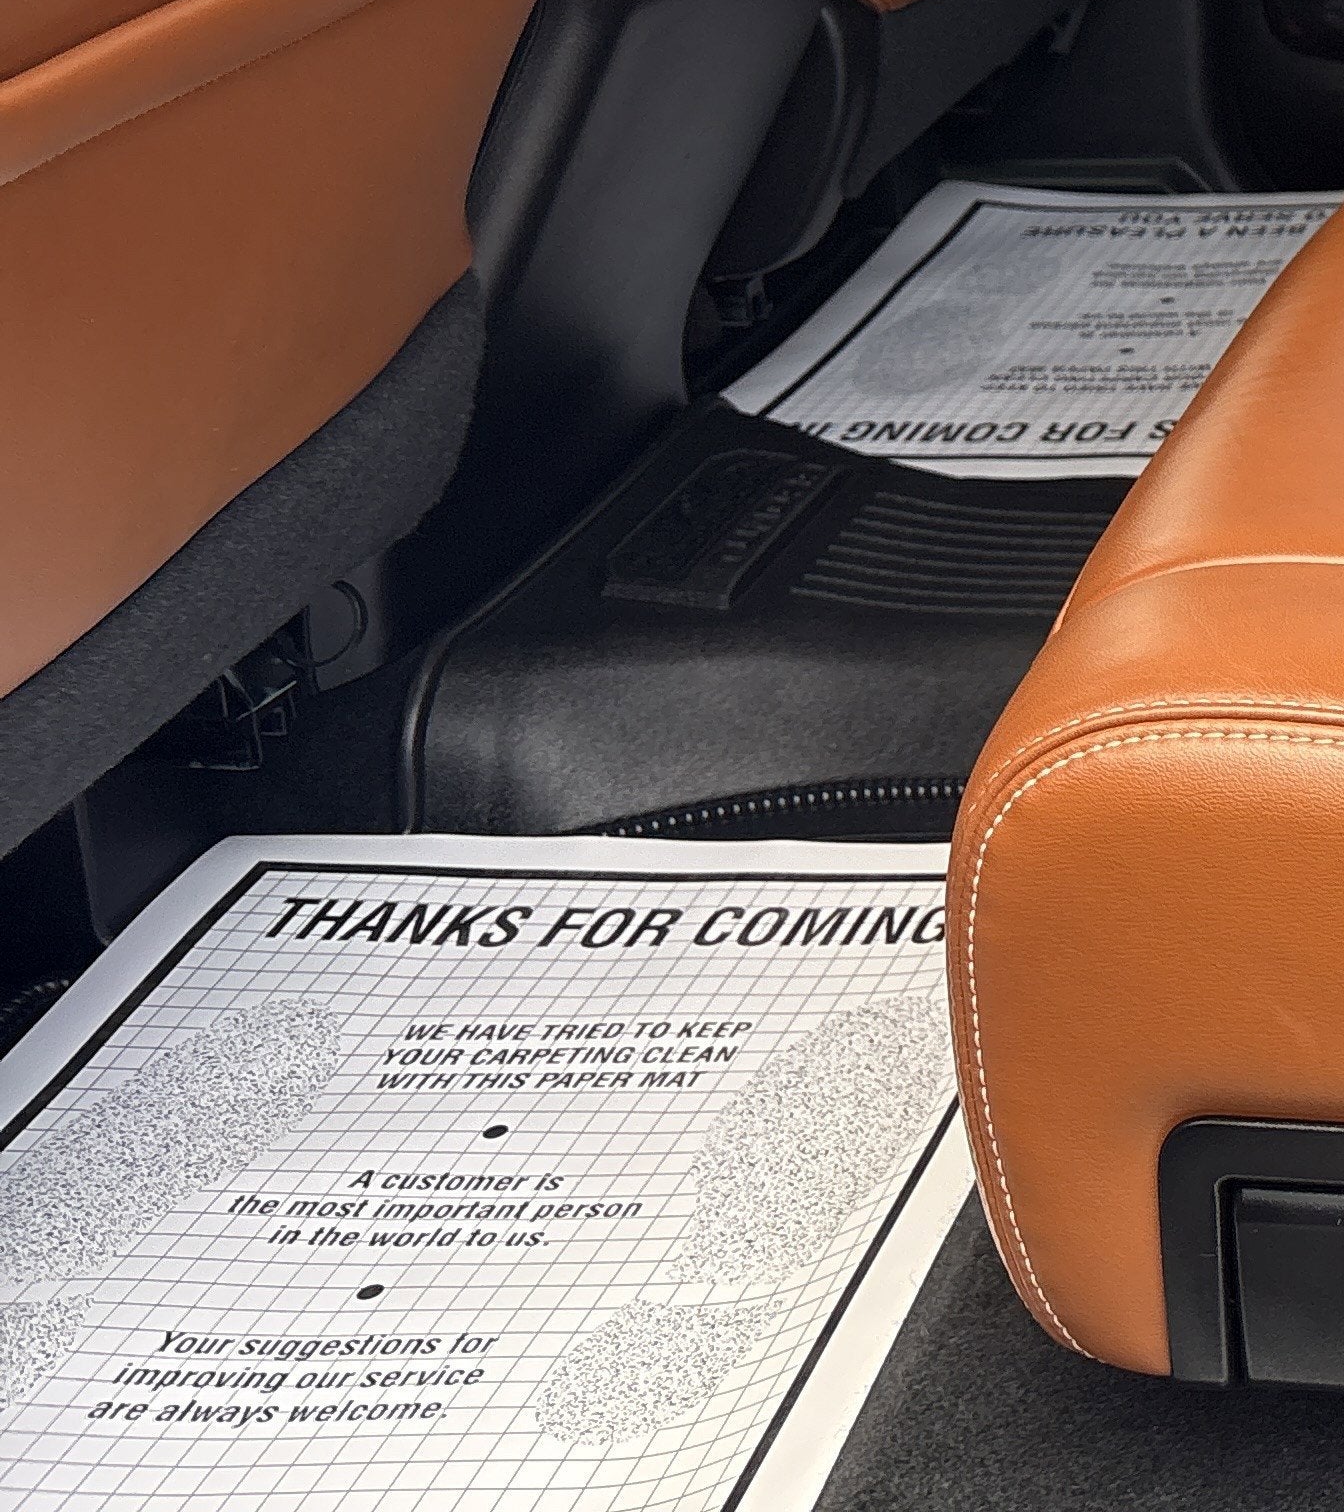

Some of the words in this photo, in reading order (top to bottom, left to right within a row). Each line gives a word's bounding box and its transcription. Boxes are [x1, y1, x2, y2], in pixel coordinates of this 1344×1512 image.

[840, 419, 1028, 443] COMING
[1040, 420, 1137, 443] FOR
[266, 897, 534, 948] THANKS
[537, 906, 684, 948] FOR
[693, 905, 946, 947] COMING
[404, 1023, 450, 1041] WE
[457, 1023, 533, 1041] HAVE
[540, 1022, 626, 1041] TRIED
[632, 1022, 674, 1039] TO
[676, 1021, 753, 1039] KEEP
[383, 1048, 466, 1066] YOUR
[469, 1046, 635, 1066] CARPETING
[640, 1045, 740, 1064] CLEAN
[376, 1072, 460, 1089] WITH
[461, 1072, 530, 1089] THIS
[533, 1071, 633, 1089] PAPER
[638, 1070, 707, 1088] MAT
[347, 1169, 376, 1189] A
[381, 1170, 530, 1191] customer
[533, 1172, 565, 1191] is
[227, 1194, 280, 1215] the
[285, 1197, 371, 1218] most
[373, 1198, 531, 1222] important
[530, 1199, 644, 1222] person
[268, 1224, 302, 1245] in
[307, 1224, 361, 1247] the
[368, 1226, 463, 1247] world
[465, 1227, 499, 1247] to
[504, 1228, 551, 1247] us.
[156, 1331, 236, 1355] Your
[238, 1333, 440, 1361] suggestions
[448, 1333, 500, 1354] for
[112, 1362, 289, 1394] improving
[295, 1369, 357, 1389] our
[360, 1364, 486, 1388] service
[87, 1400, 150, 1421] are
[155, 1399, 280, 1428] always
[287, 1399, 449, 1424] welcome.
